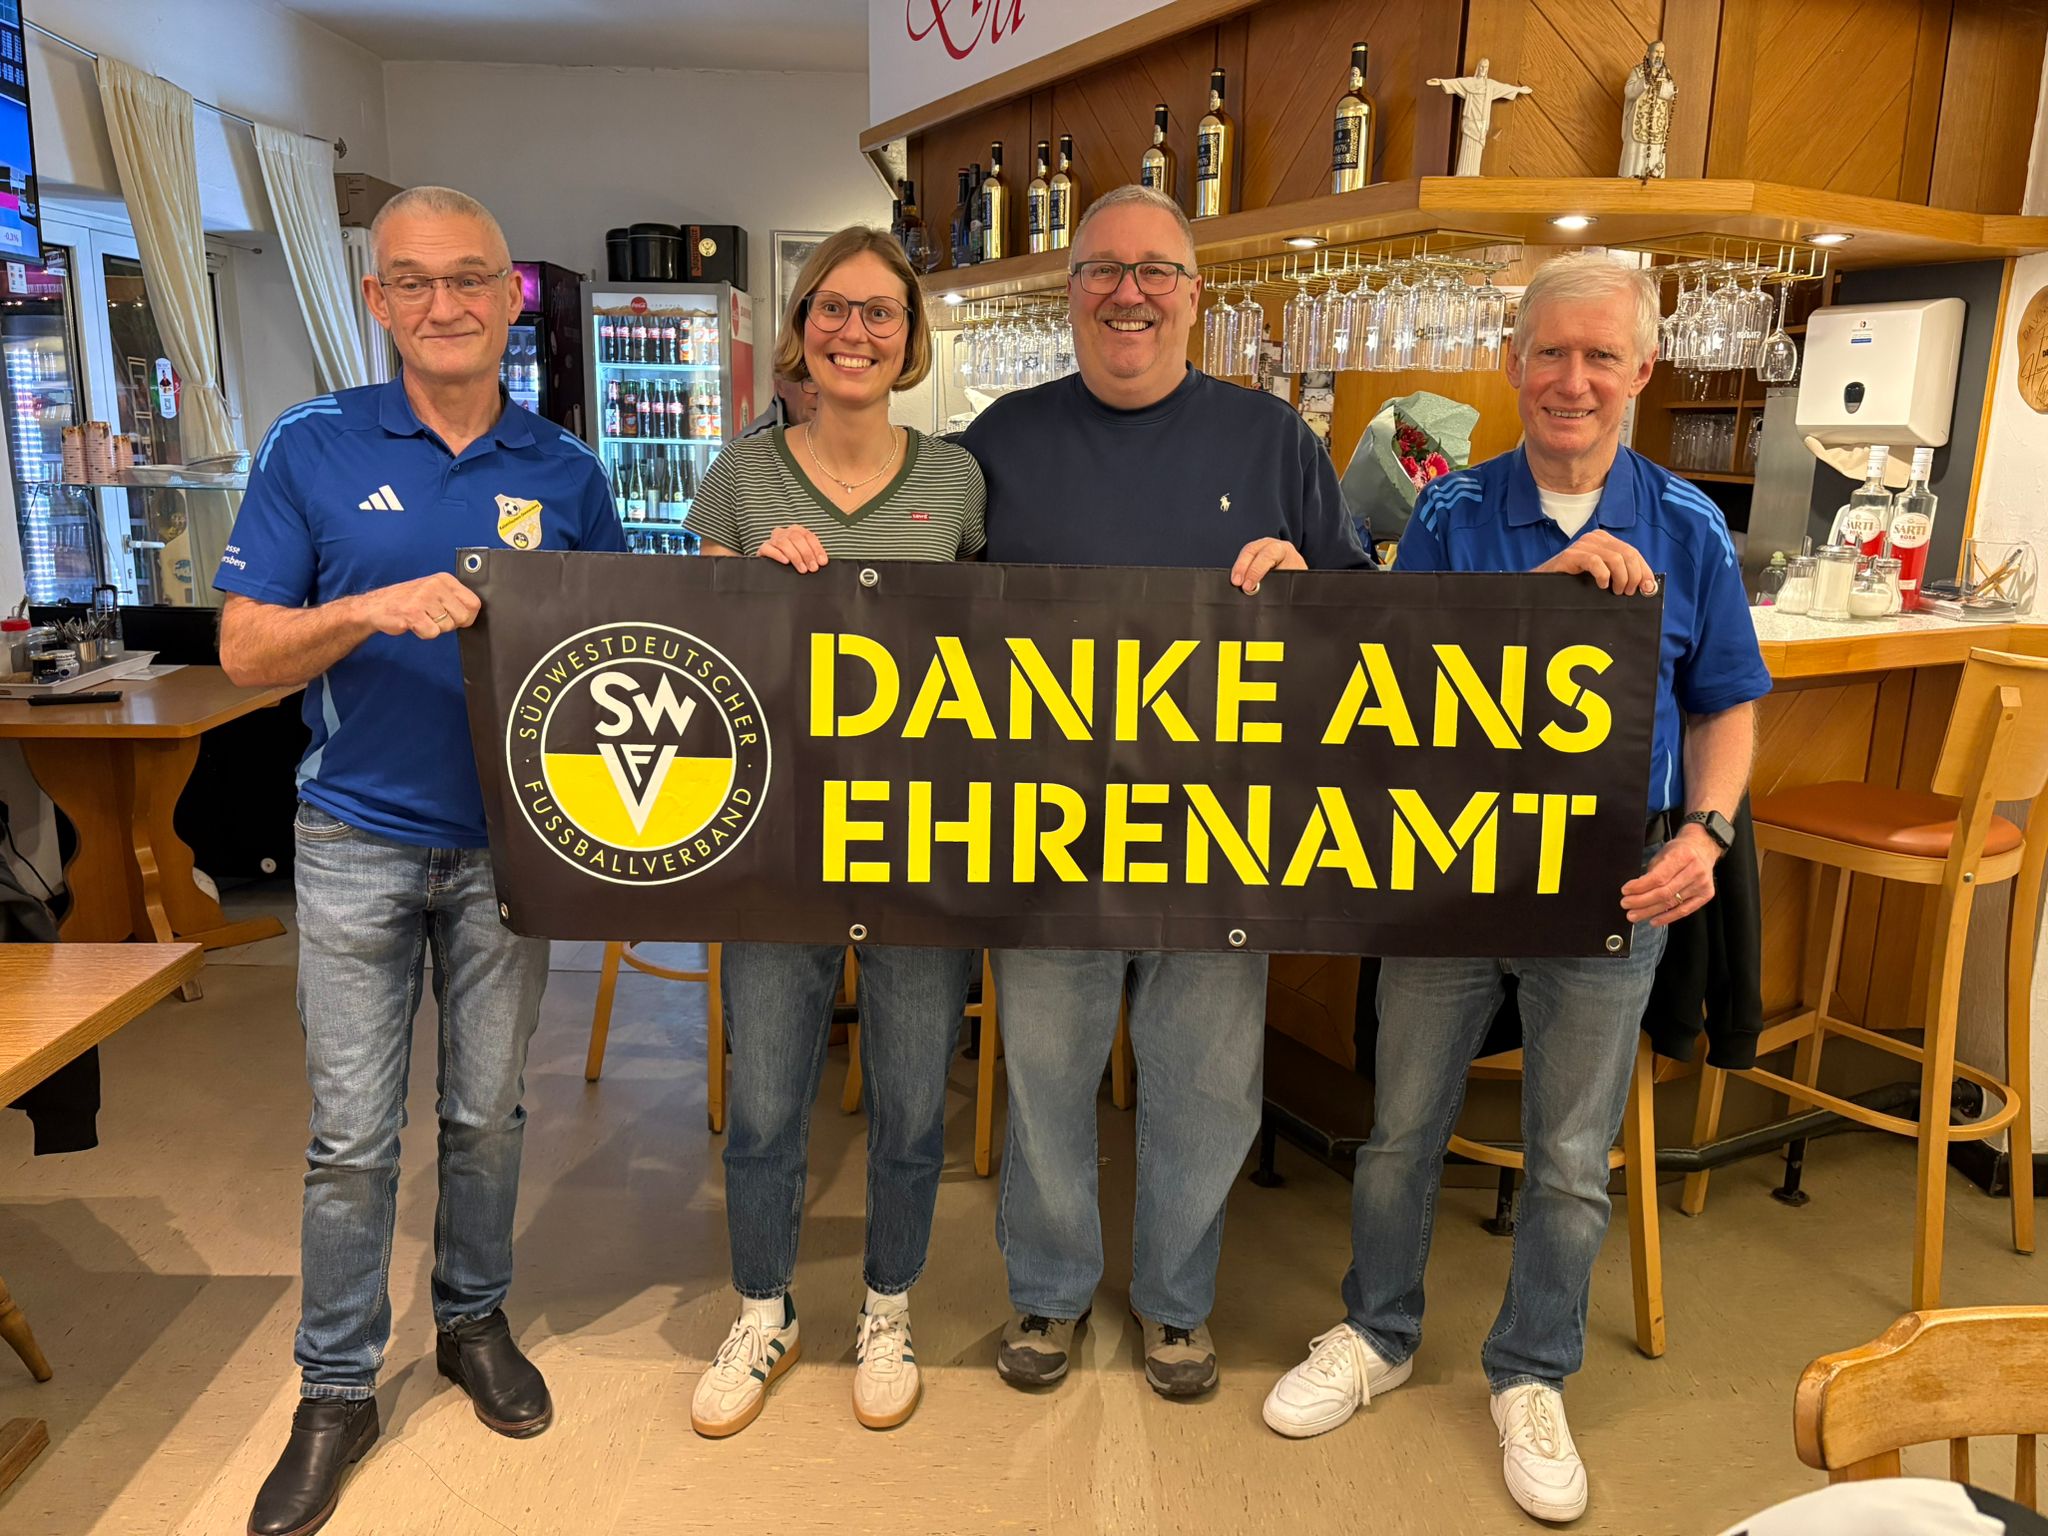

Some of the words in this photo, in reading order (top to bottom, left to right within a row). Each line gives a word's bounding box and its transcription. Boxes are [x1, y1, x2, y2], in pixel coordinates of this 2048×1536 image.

[1894, 523, 1926, 536] SARTI
[519, 635, 757, 747] SÜDWESTDEUTSCHER
[810, 632, 1285, 743] DANKE
[1321, 643, 1614, 753] ANS
[524, 780, 753, 876] FUSSBALLVERBAND
[822, 781, 1597, 894] EHRENAMT
